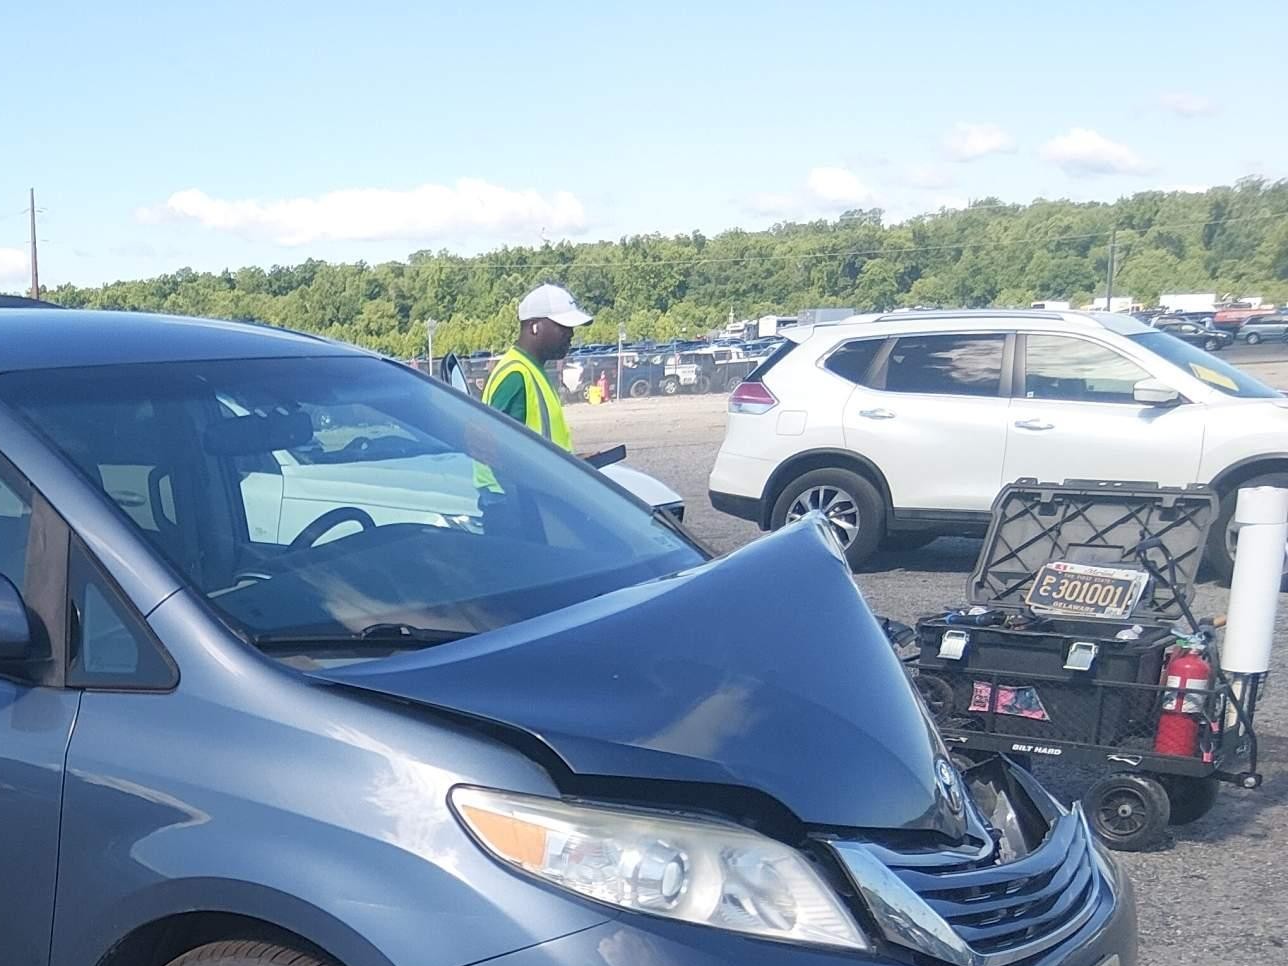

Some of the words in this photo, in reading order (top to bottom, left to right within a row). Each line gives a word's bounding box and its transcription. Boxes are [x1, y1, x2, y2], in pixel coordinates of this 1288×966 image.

[1052, 579, 1123, 608] 301001
[1052, 601, 1097, 613] DELAWARE
[1012, 743, 1033, 752] BILT
[1033, 746, 1062, 756] HARD
